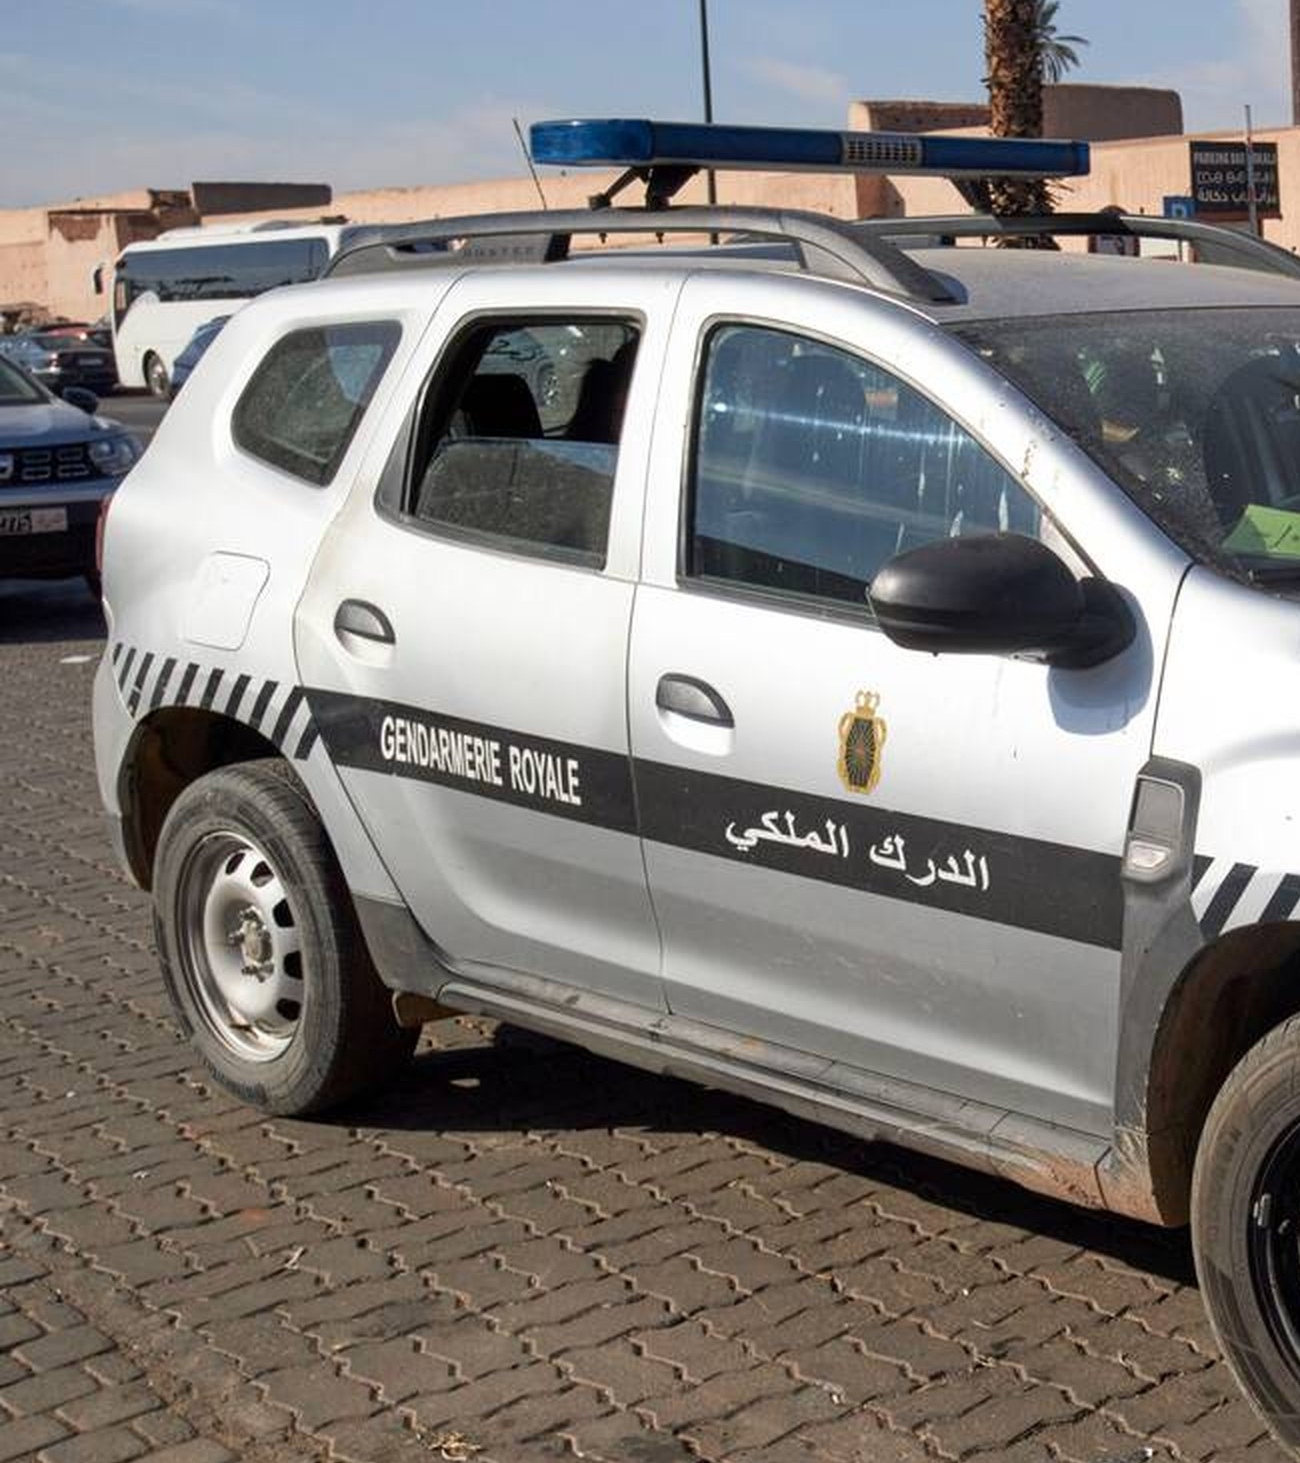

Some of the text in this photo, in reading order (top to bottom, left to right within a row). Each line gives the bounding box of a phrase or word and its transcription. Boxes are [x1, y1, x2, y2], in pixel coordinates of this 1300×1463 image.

[380, 715, 582, 806] GENDARMERIE ROYALE
[725, 810, 991, 891] الدرك الملكي
